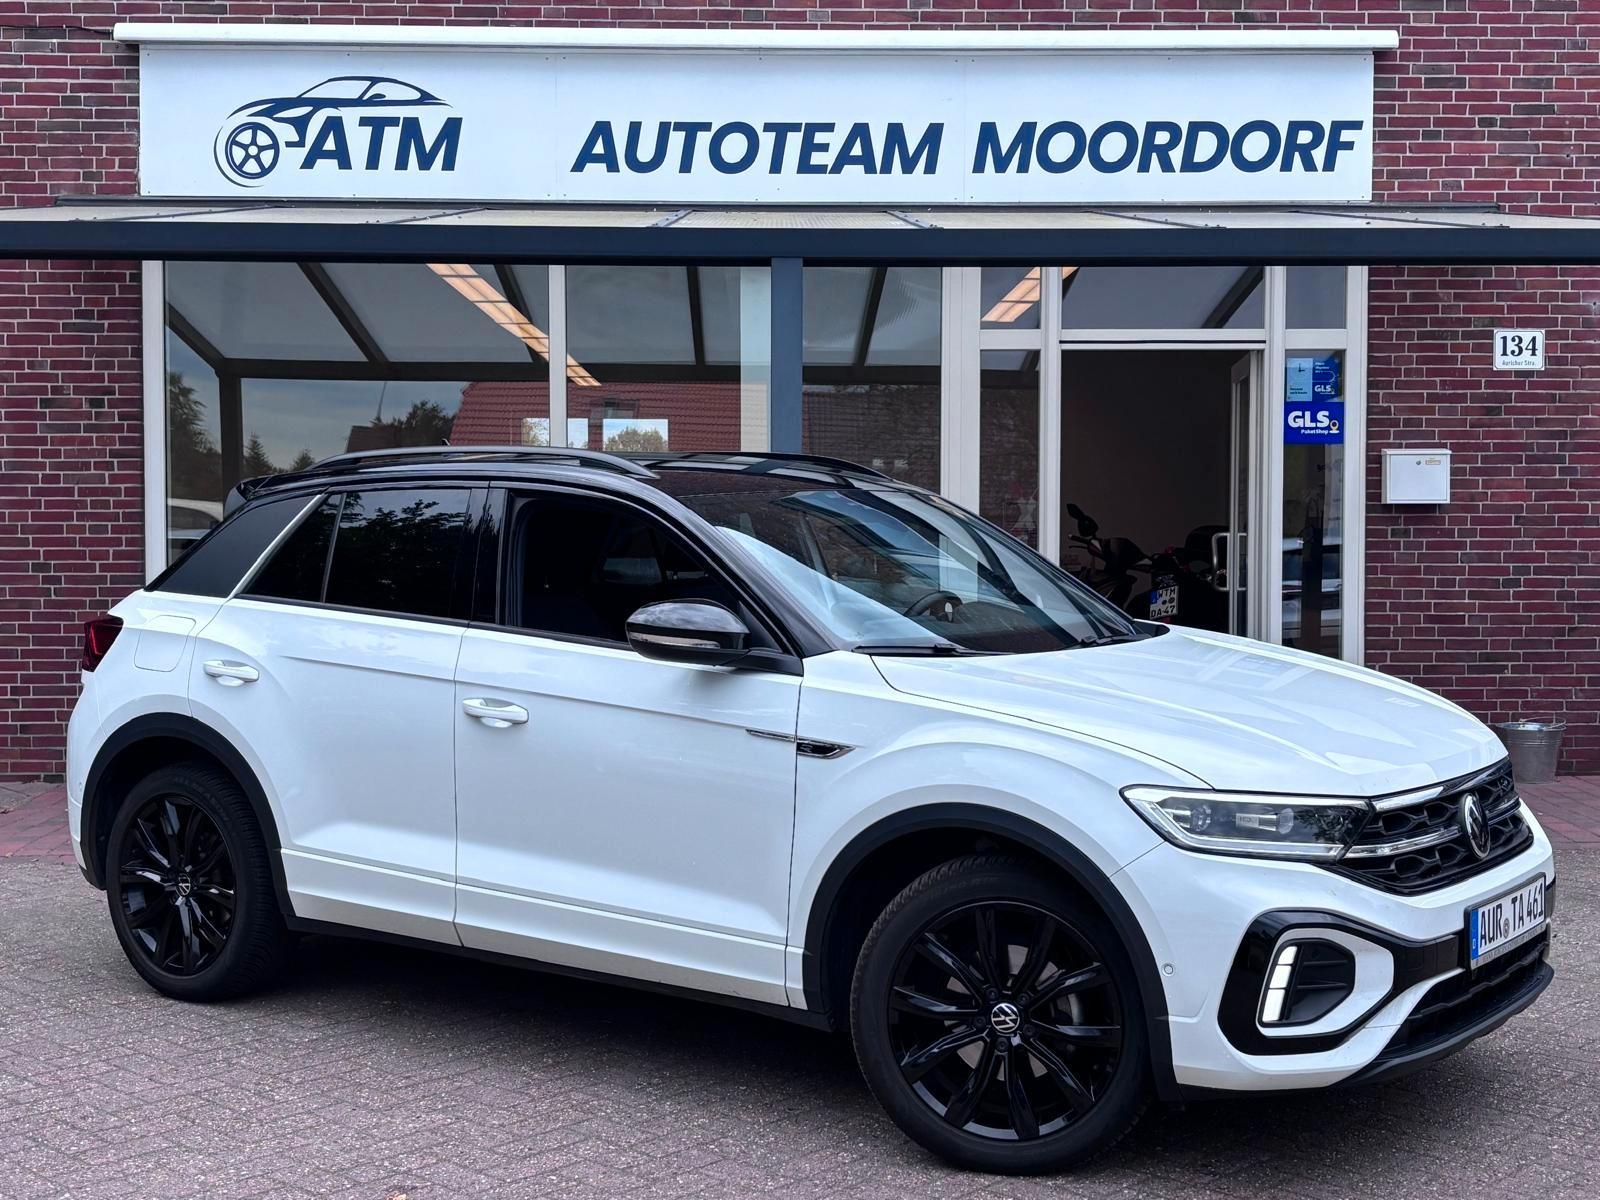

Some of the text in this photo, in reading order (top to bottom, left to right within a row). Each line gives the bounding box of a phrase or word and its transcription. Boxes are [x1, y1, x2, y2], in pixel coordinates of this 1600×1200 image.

[300, 116, 463, 171] ATM
[570, 120, 1363, 174] AUTOTEAM MOORDORF
[1500, 335, 1538, 356] 134
[1314, 384, 1331, 392] GLS
[1287, 410, 1330, 428] GLS
[1480, 903, 1502, 947] AUR
[1511, 893, 1524, 932] TA
[1526, 882, 1543, 922] 461
